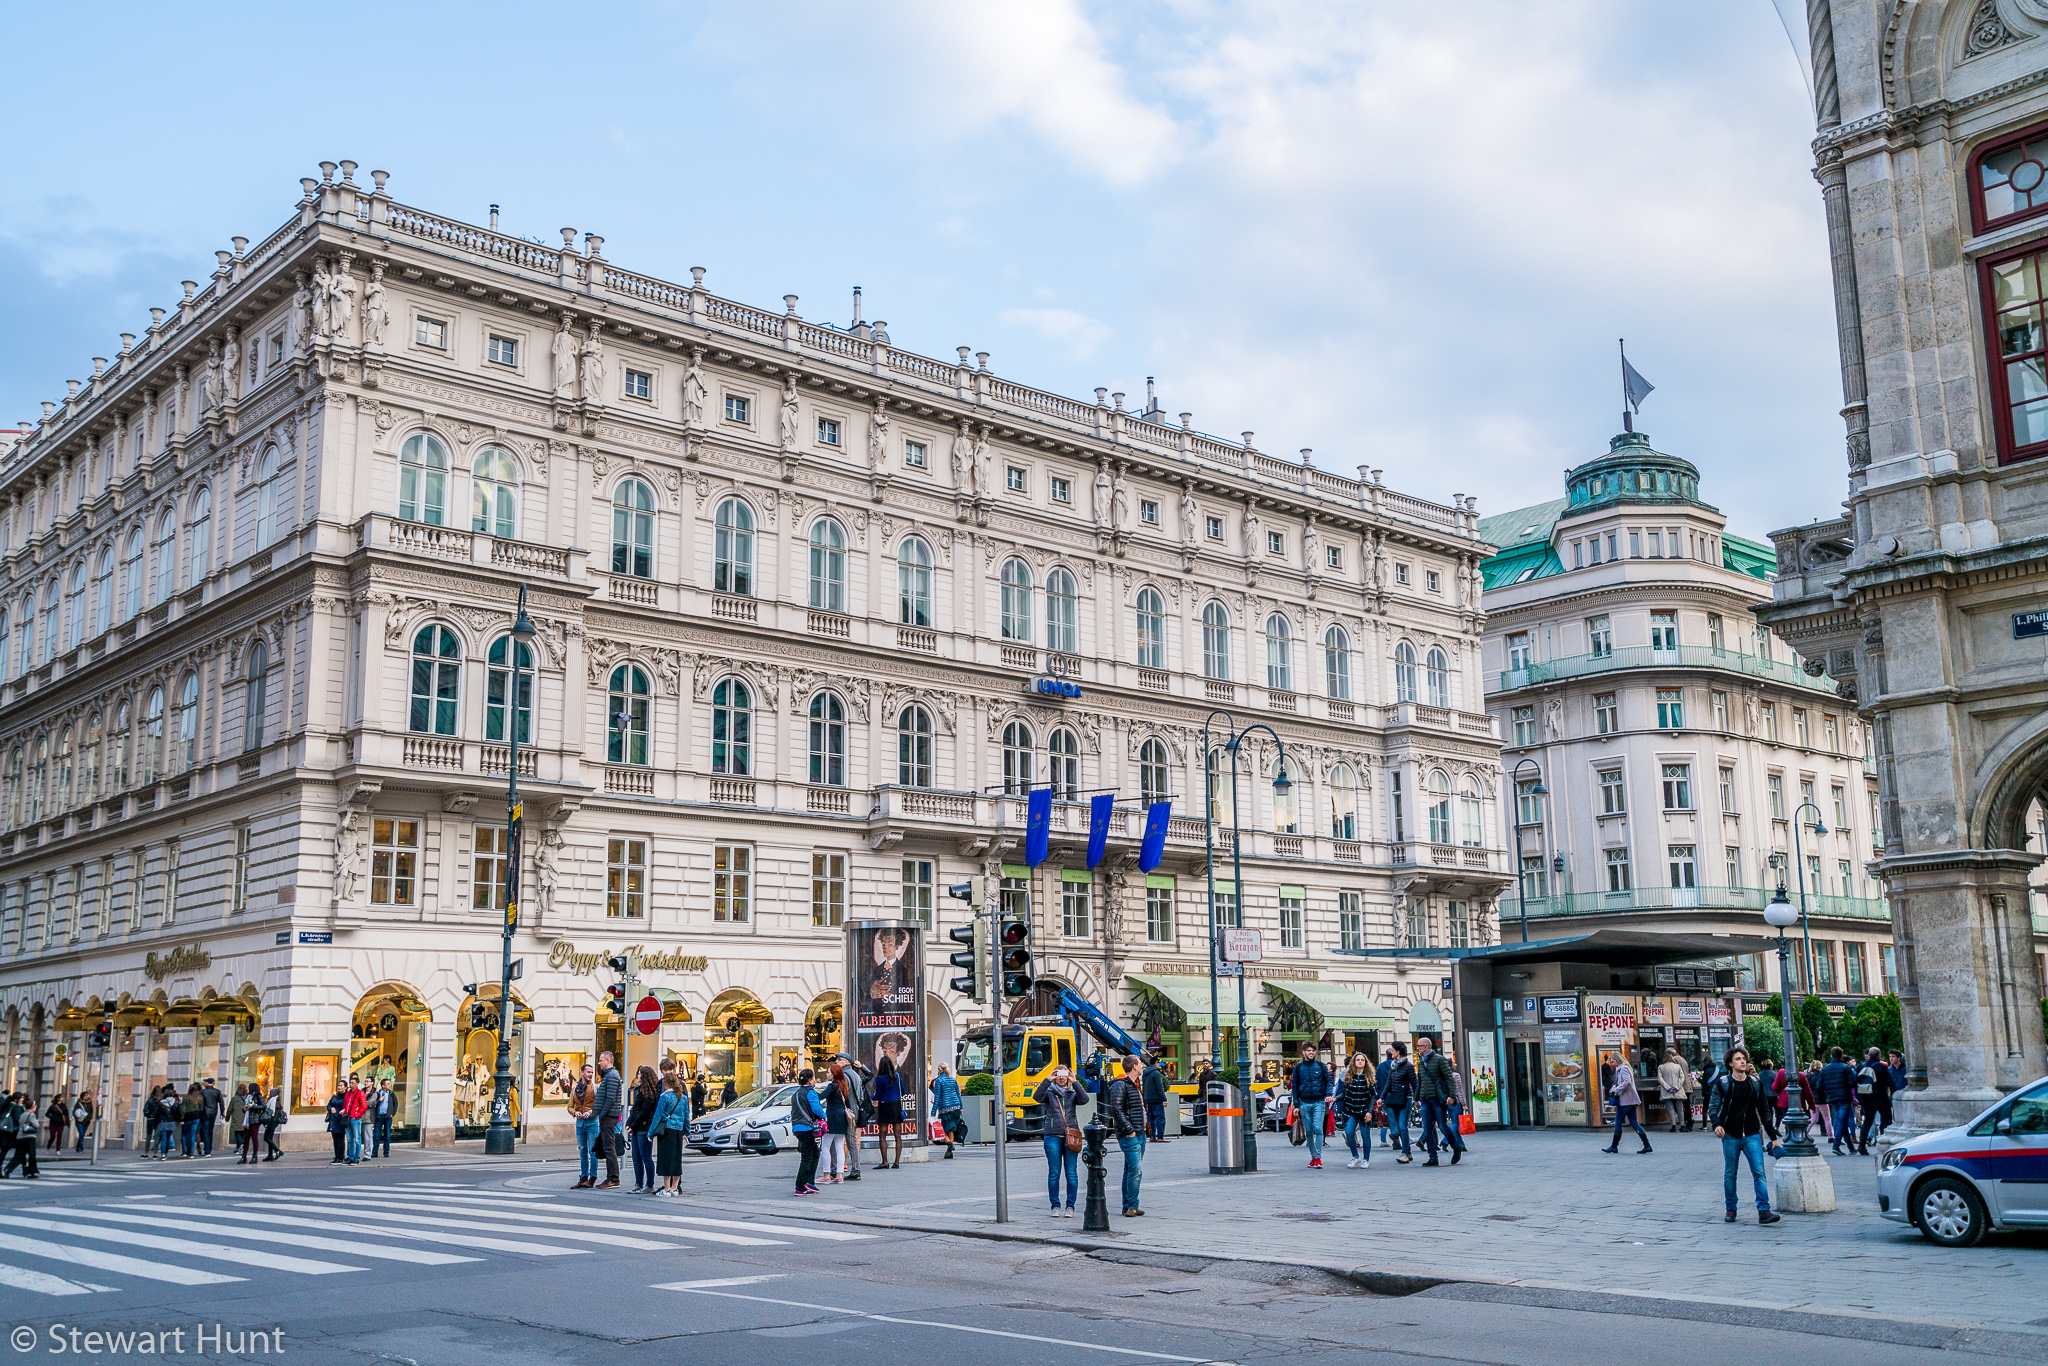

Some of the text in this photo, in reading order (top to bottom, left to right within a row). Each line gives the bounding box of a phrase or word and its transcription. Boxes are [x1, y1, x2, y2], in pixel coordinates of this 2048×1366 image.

[1040, 678, 1082, 697] UNIQA
[547, 940, 600, 976] Popp
[883, 994, 914, 1004] SCHIELE
[1587, 1001, 1604, 1015] Don
[1605, 1001, 1635, 1015] Camillo
[1685, 1008, 1700, 1016] 58885
[1749, 1004, 1762, 1012] LOVE
[858, 1015, 916, 1027] ALBERTINA
[902, 1101, 916, 1110] IELE
[861, 1123, 917, 1135] ALBRINA
